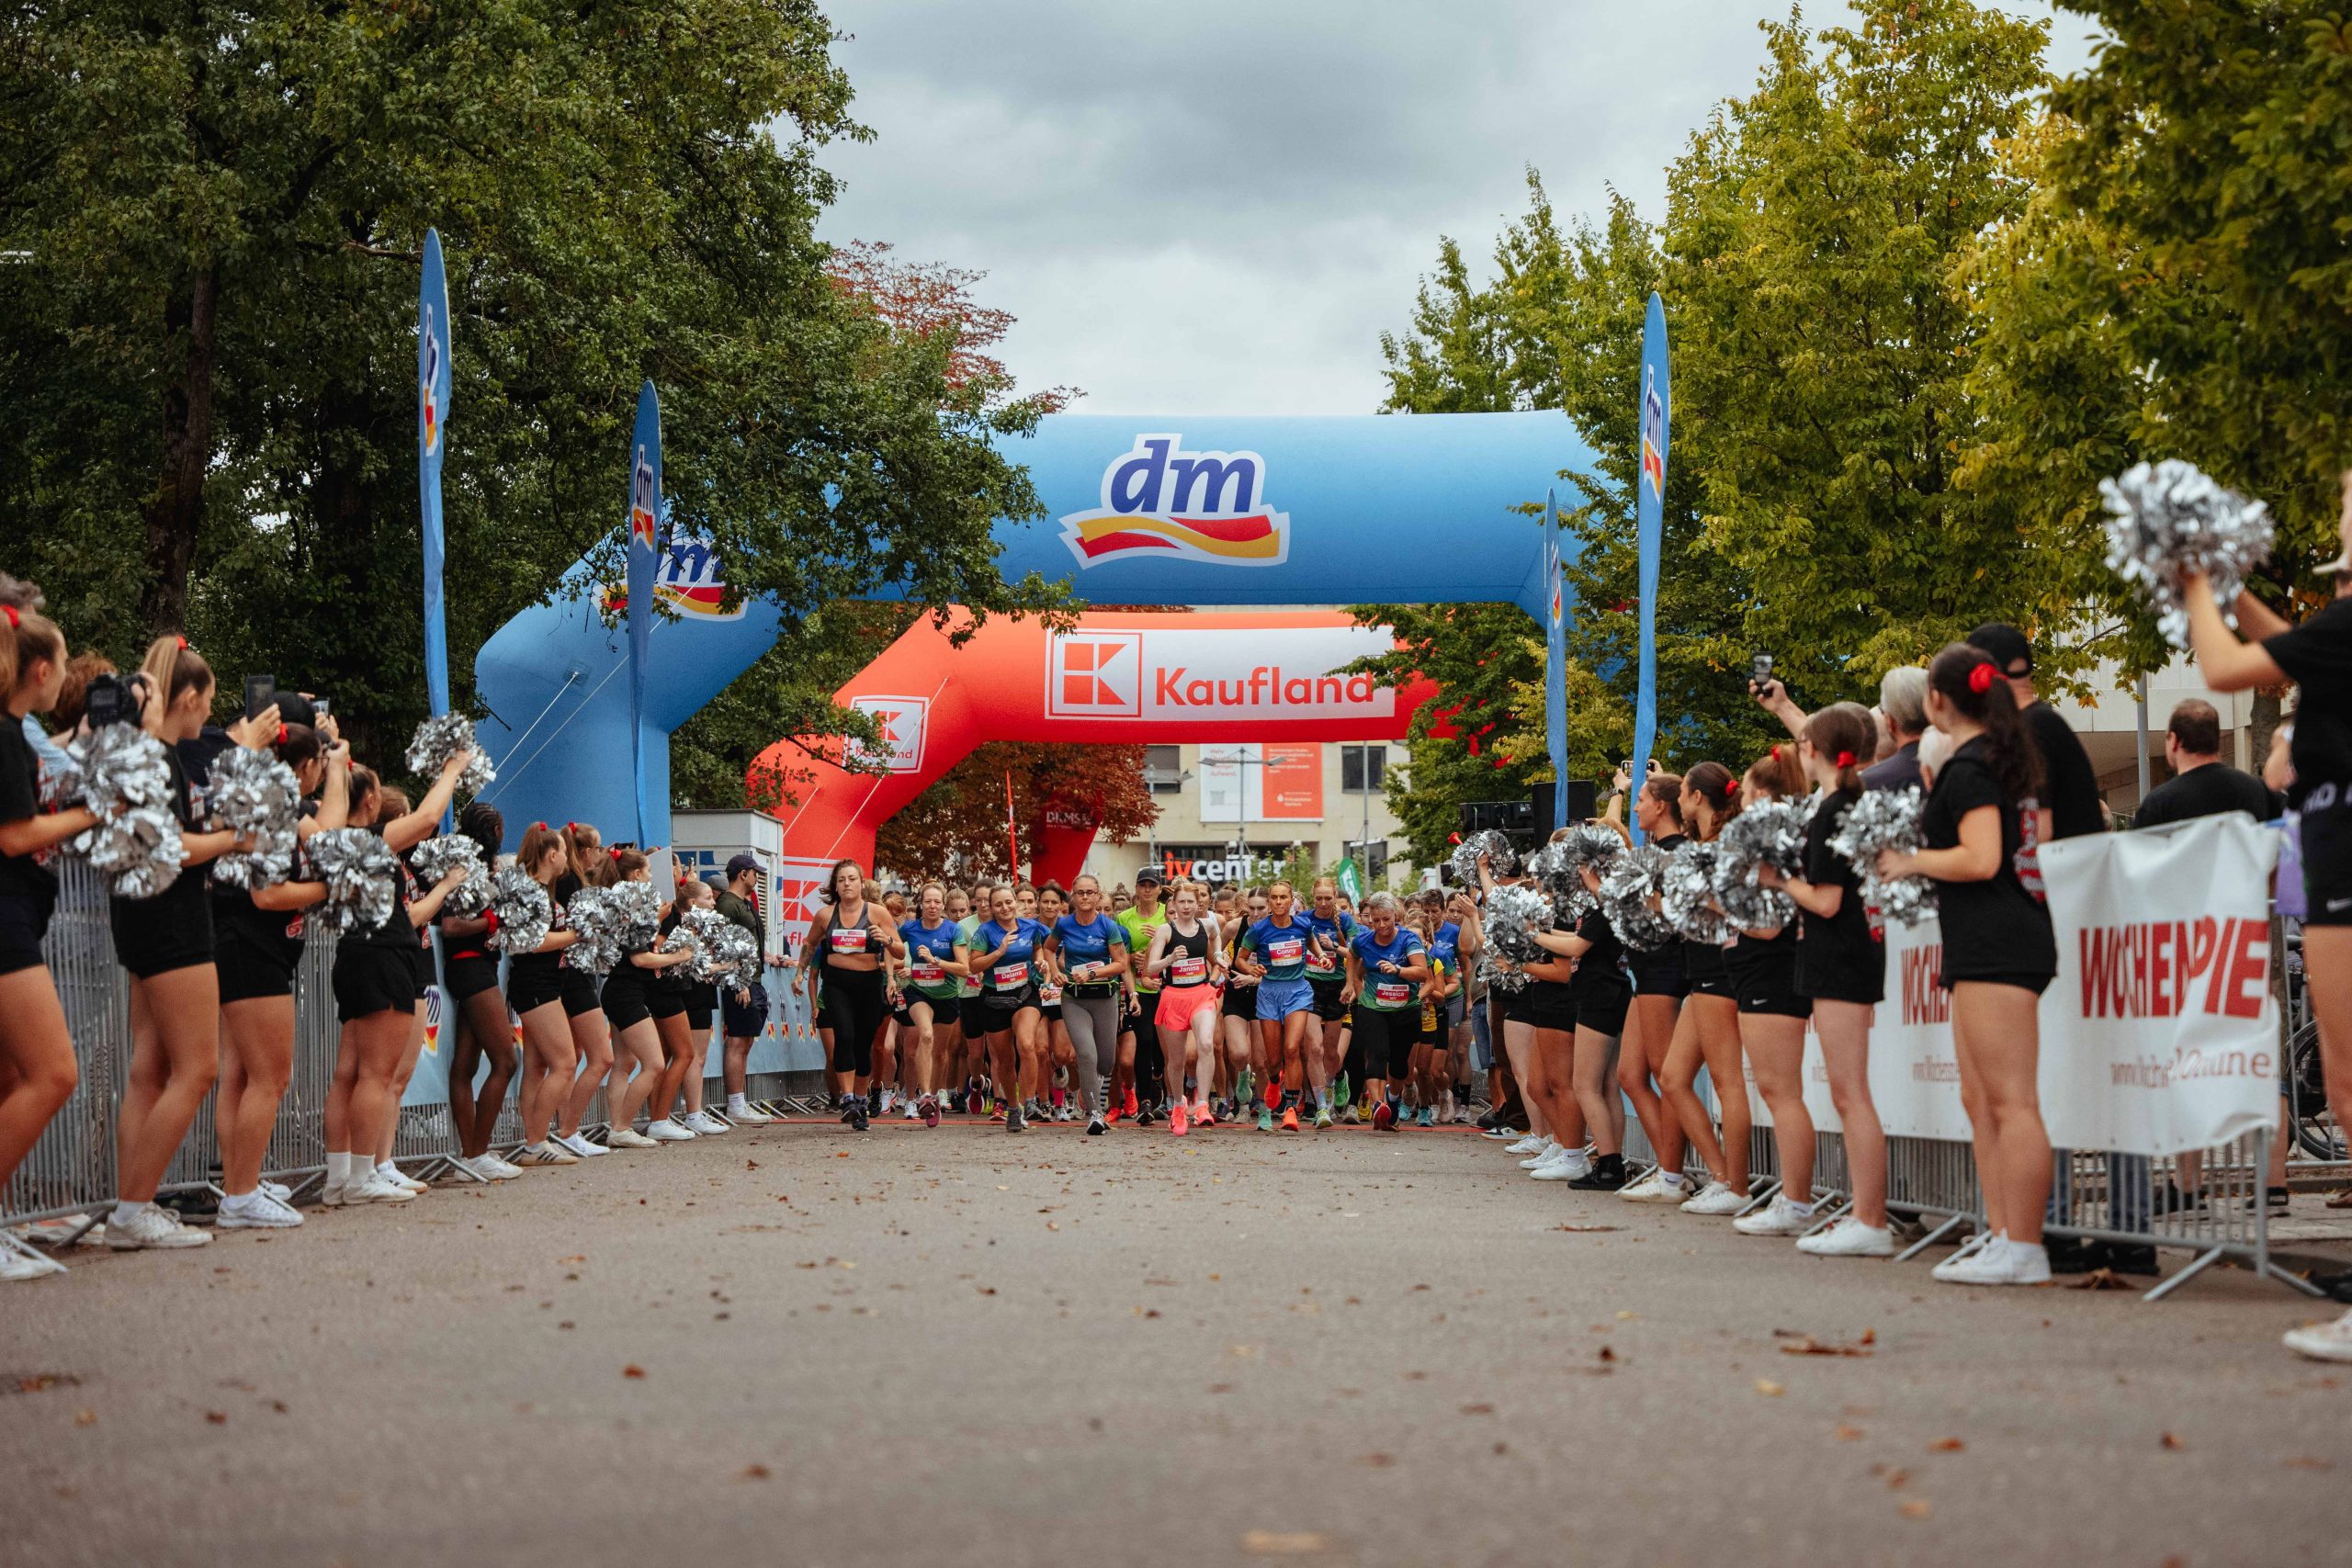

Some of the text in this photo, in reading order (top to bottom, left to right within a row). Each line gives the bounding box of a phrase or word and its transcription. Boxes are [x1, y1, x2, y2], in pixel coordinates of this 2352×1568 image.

[637, 450, 652, 513] dm
[1111, 439, 1257, 513] dm
[1156, 666, 1374, 705] Kaufland
[1276, 948, 1296, 956] Conny
[1381, 989, 1405, 998] Jessica
